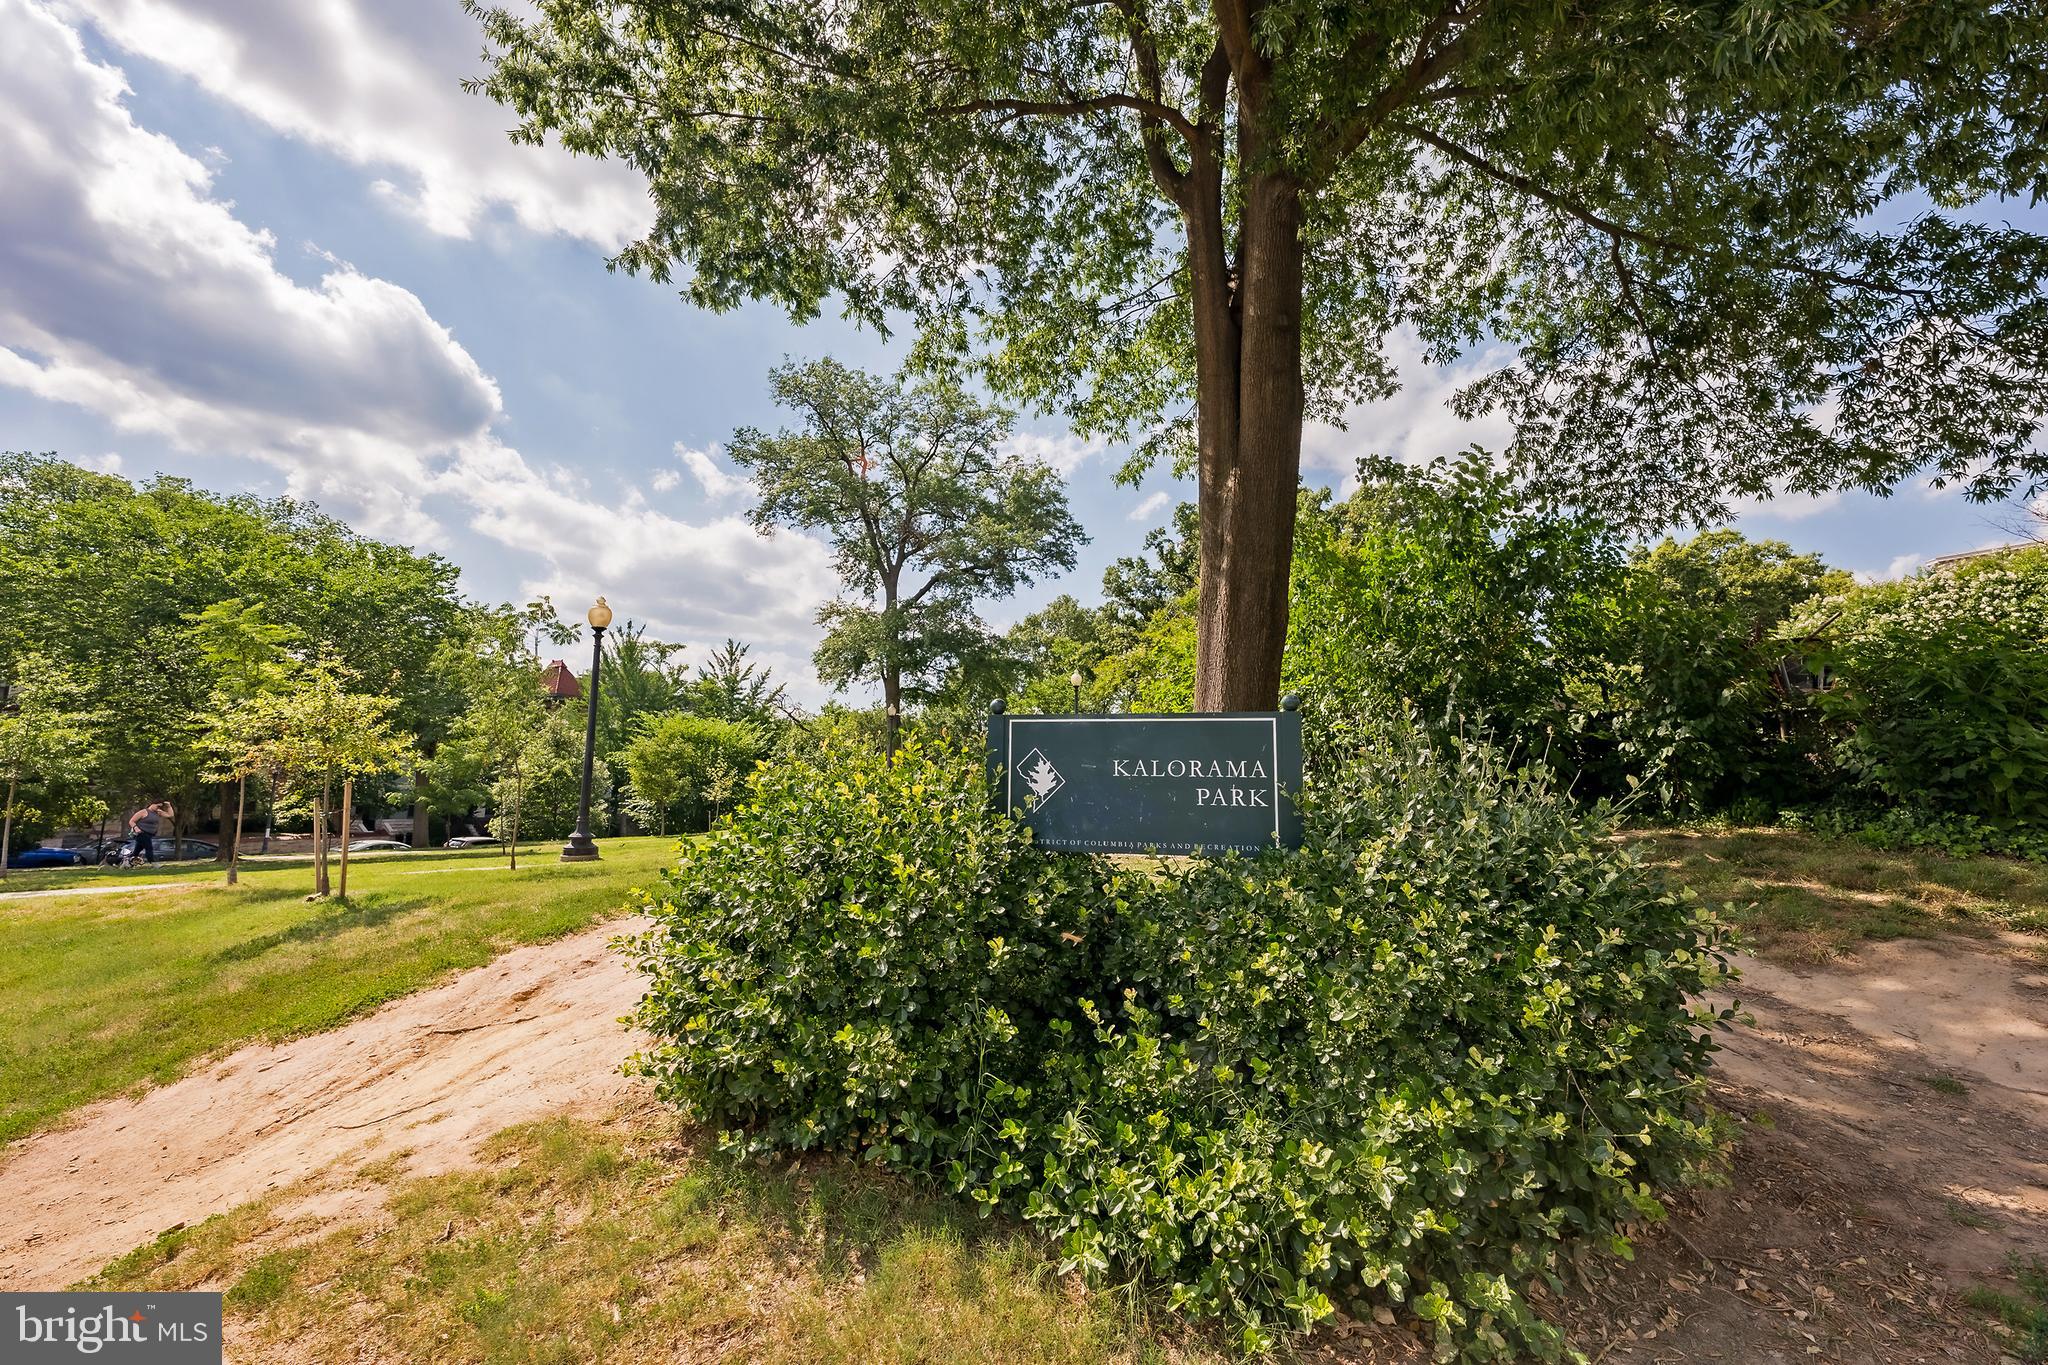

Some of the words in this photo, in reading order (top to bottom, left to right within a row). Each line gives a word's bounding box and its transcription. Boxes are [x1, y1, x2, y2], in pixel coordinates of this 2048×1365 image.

[1112, 759, 1268, 779] KALORAMA
[1195, 787, 1269, 807] PARK
[1034, 838, 1068, 846] TRICT
[1084, 839, 1134, 849] COLUMBIA
[1136, 841, 1167, 849] PARKS
[1170, 842, 1191, 850] AND
